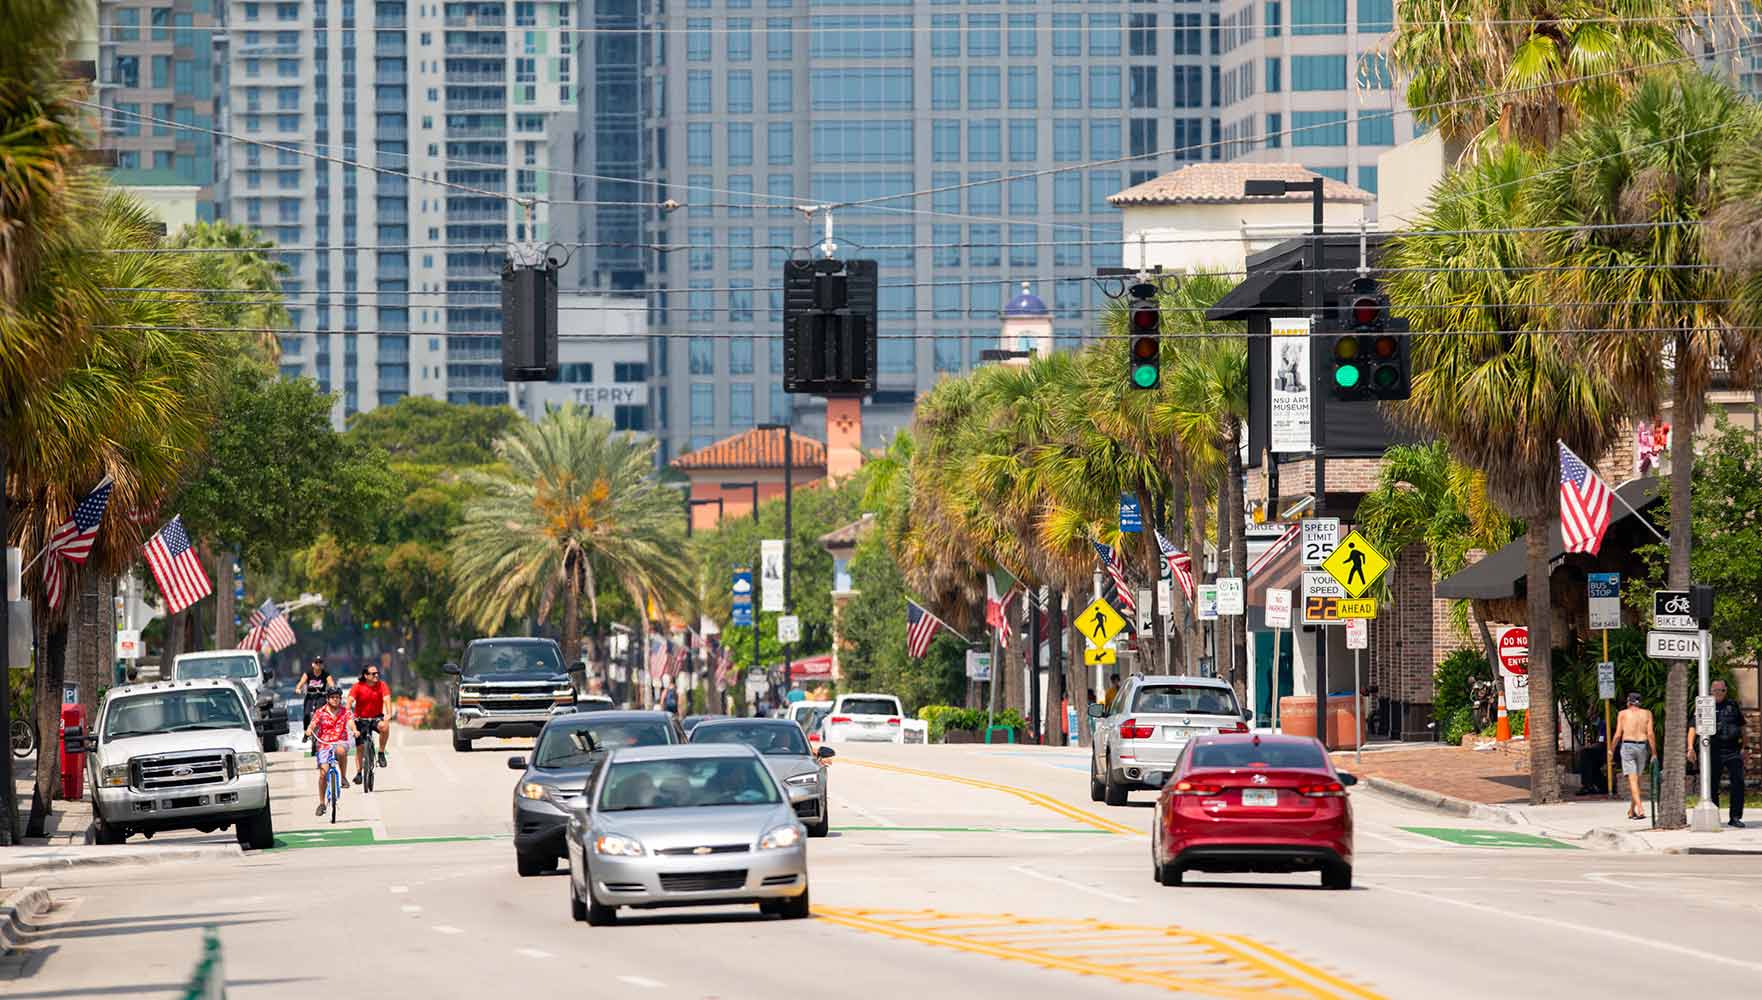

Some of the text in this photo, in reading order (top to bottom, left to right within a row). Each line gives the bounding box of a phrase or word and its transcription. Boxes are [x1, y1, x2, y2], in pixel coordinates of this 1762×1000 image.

[572, 387, 634, 402] TERRY
[1304, 523, 1336, 532] SPEED
[1308, 533, 1332, 541] LIMIT
[1306, 543, 1333, 560] 25
[1312, 576, 1337, 585] YOUR
[1310, 586, 1339, 594] SPEED
[1590, 582, 1607, 590] BUS
[1591, 589, 1612, 597] STOP
[1306, 596, 1338, 620] 22
[1341, 603, 1371, 614] AHEAD
[1657, 616, 1698, 626] BIKE LAN
[1503, 637, 1528, 646] DO NO
[1657, 639, 1700, 652] BEGIN
[1507, 658, 1528, 666] ENTE
